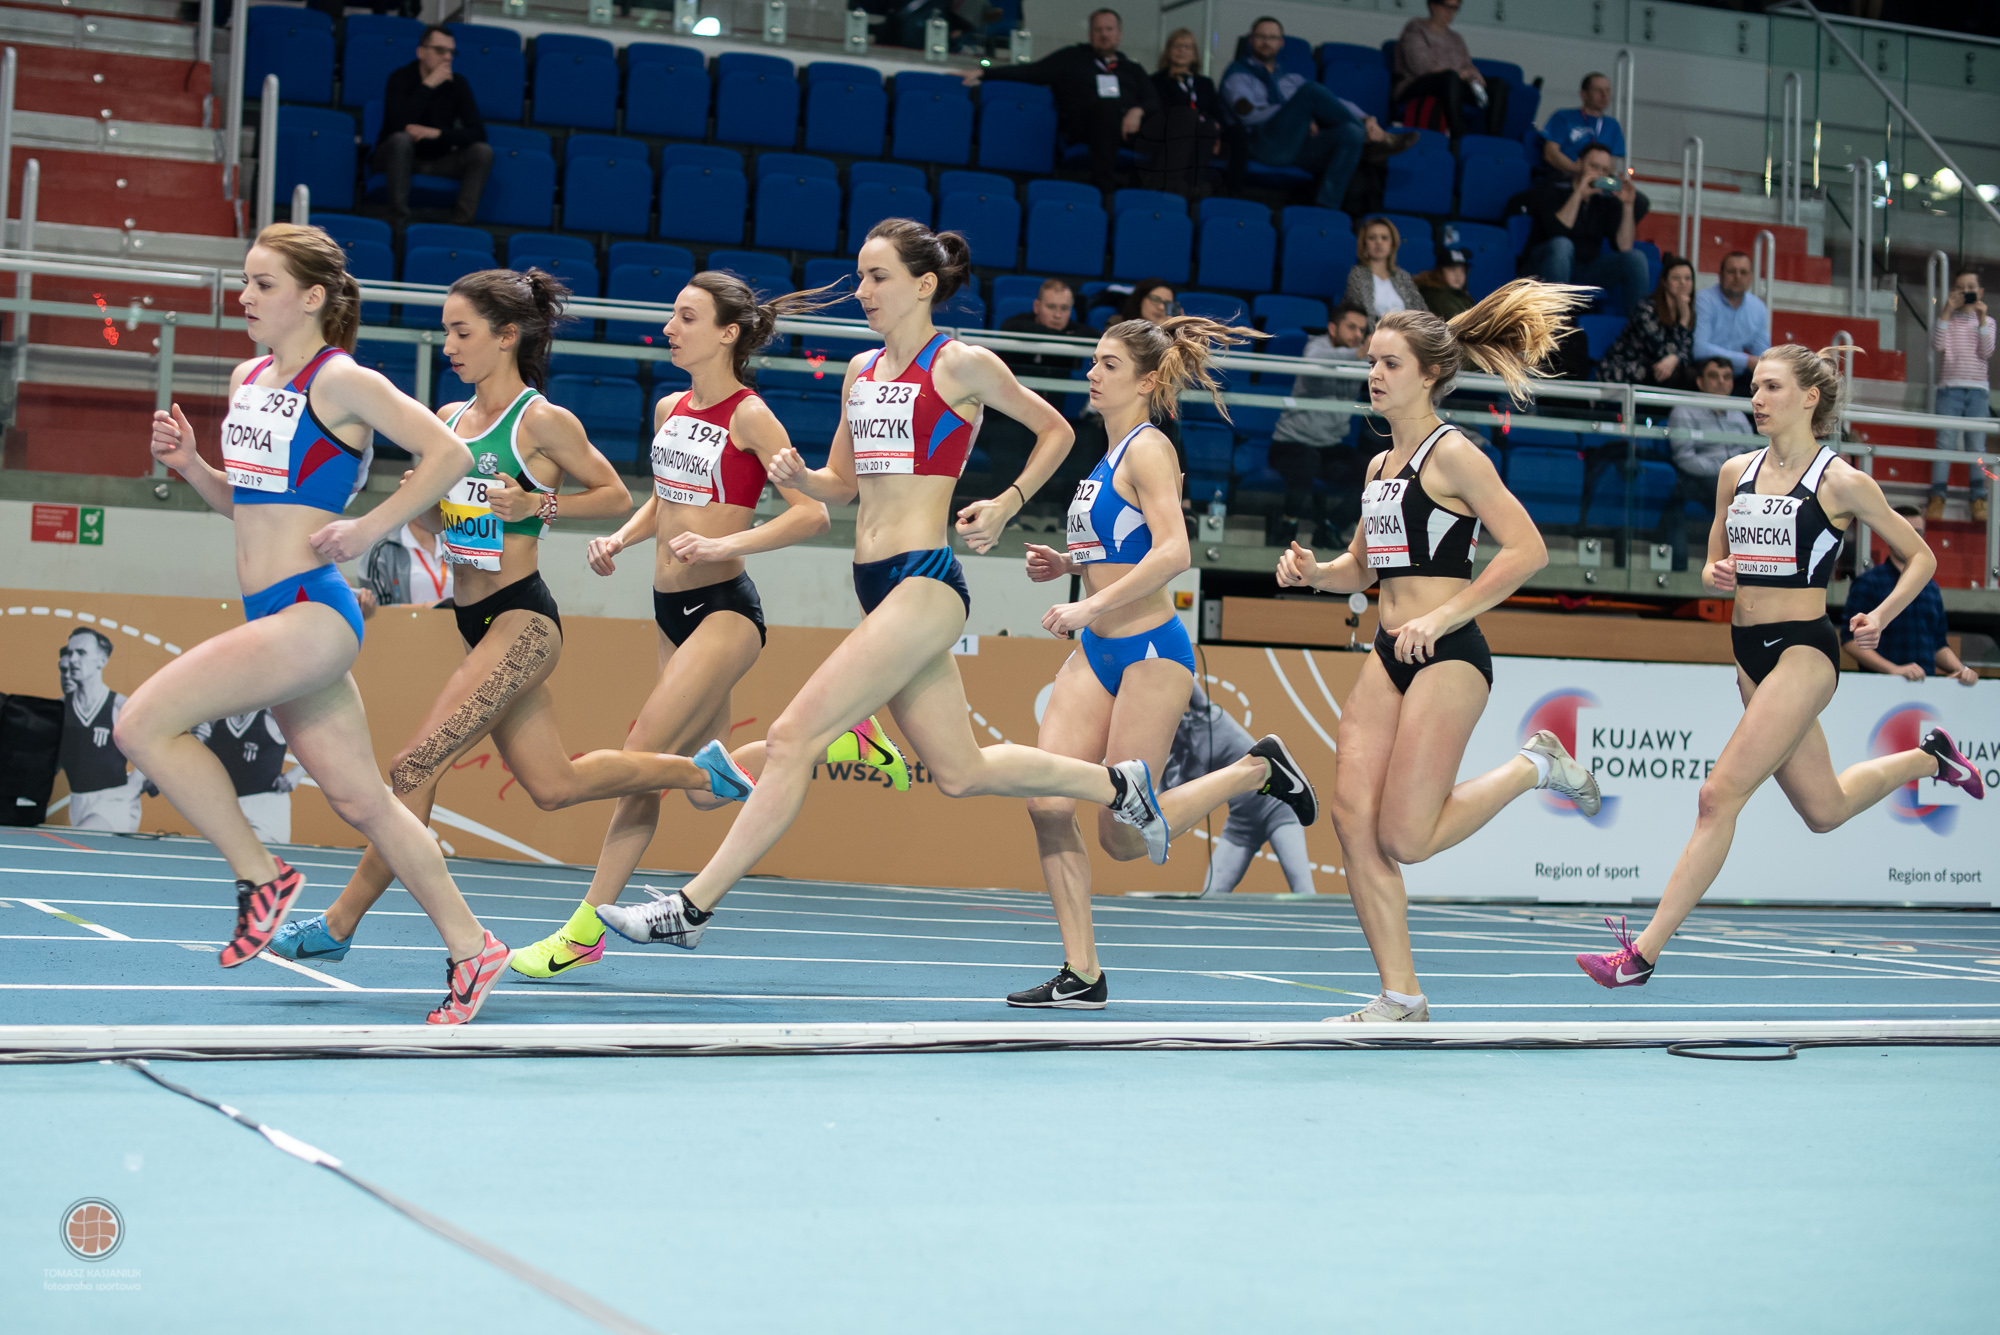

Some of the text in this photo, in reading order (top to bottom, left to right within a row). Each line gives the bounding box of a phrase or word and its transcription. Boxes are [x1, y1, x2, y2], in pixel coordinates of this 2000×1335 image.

[876, 385, 913, 404] 323
[260, 392, 298, 418] 293
[226, 422, 272, 453] TOPKA
[687, 422, 722, 447] 194
[870, 461, 890, 470] 2019
[239, 473, 263, 487] 2019
[466, 481, 488, 503] 78
[673, 491, 694, 502] 2019
[1762, 498, 1793, 516] 376
[1728, 526, 1792, 546] SARNECKA
[1373, 555, 1390, 566] 2019
[1759, 564, 1778, 573] 2019
[961, 637, 968, 653] 1
[1592, 727, 1693, 751] KUJAWY
[1591, 757, 1716, 780] POMORZE
[1535, 862, 1641, 881] Region of sport
[1888, 867, 1982, 885] Region of sport
